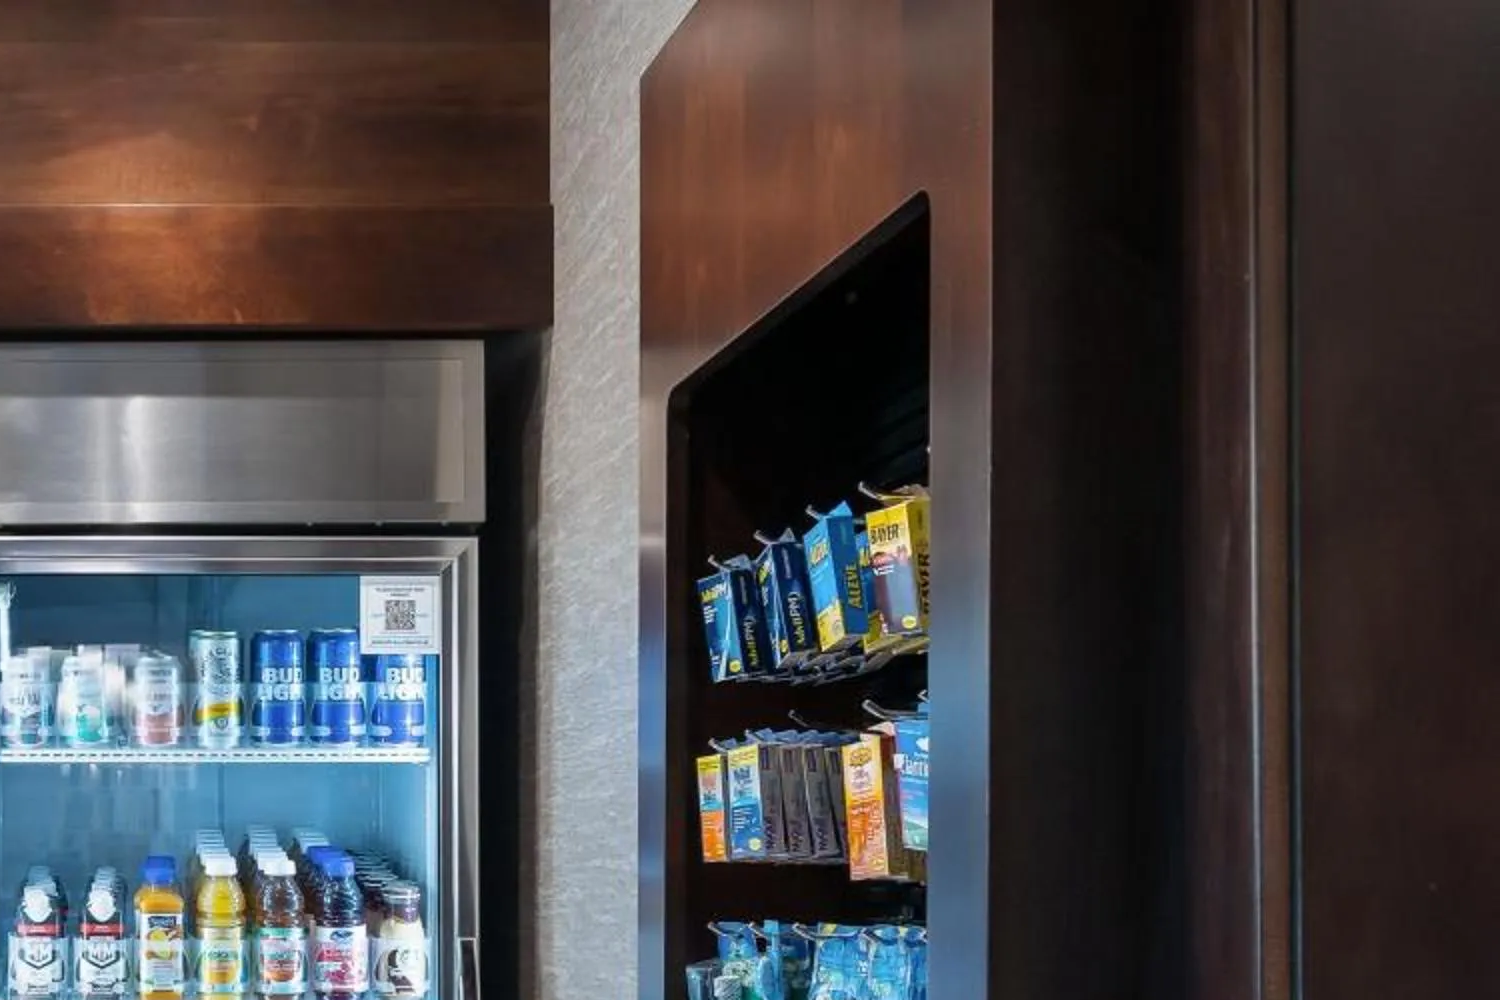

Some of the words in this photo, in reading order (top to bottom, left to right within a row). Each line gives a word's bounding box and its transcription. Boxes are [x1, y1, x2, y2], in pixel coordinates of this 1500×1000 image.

[870, 523, 900, 545] BAYER
[262, 667, 302, 683] BUD
[319, 667, 360, 683] BUD
